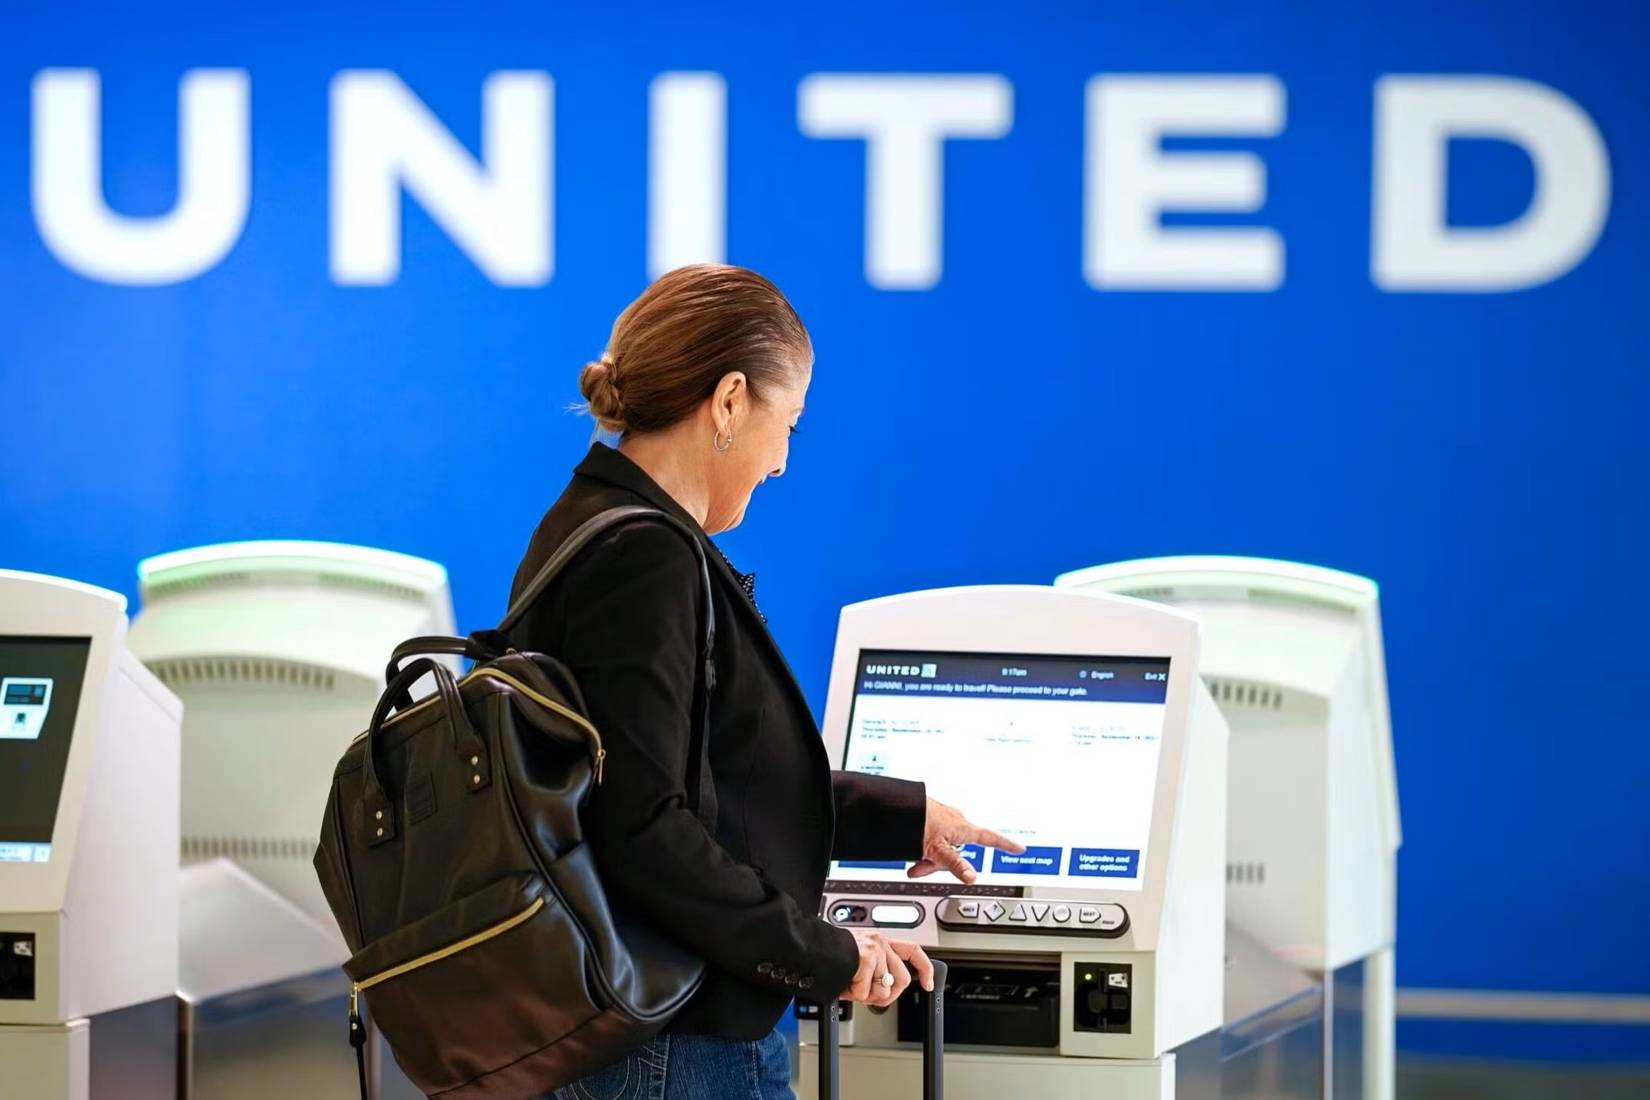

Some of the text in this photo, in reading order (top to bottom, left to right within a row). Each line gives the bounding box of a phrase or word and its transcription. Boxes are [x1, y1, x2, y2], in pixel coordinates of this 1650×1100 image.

[30, 66, 1612, 294] UNITED
[866, 665, 920, 675] UNITED
[905, 684, 919, 692] you
[933, 684, 954, 693] ready
[954, 684, 963, 692] to
[987, 685, 1012, 693] Please
[1012, 687, 1043, 695] proceed
[1043, 686, 1052, 695] to
[1052, 687, 1069, 697] your
[1000, 855, 1054, 867] View seat map
[1079, 854, 1131, 865] Upgrades and
[1079, 863, 1128, 873] other options
